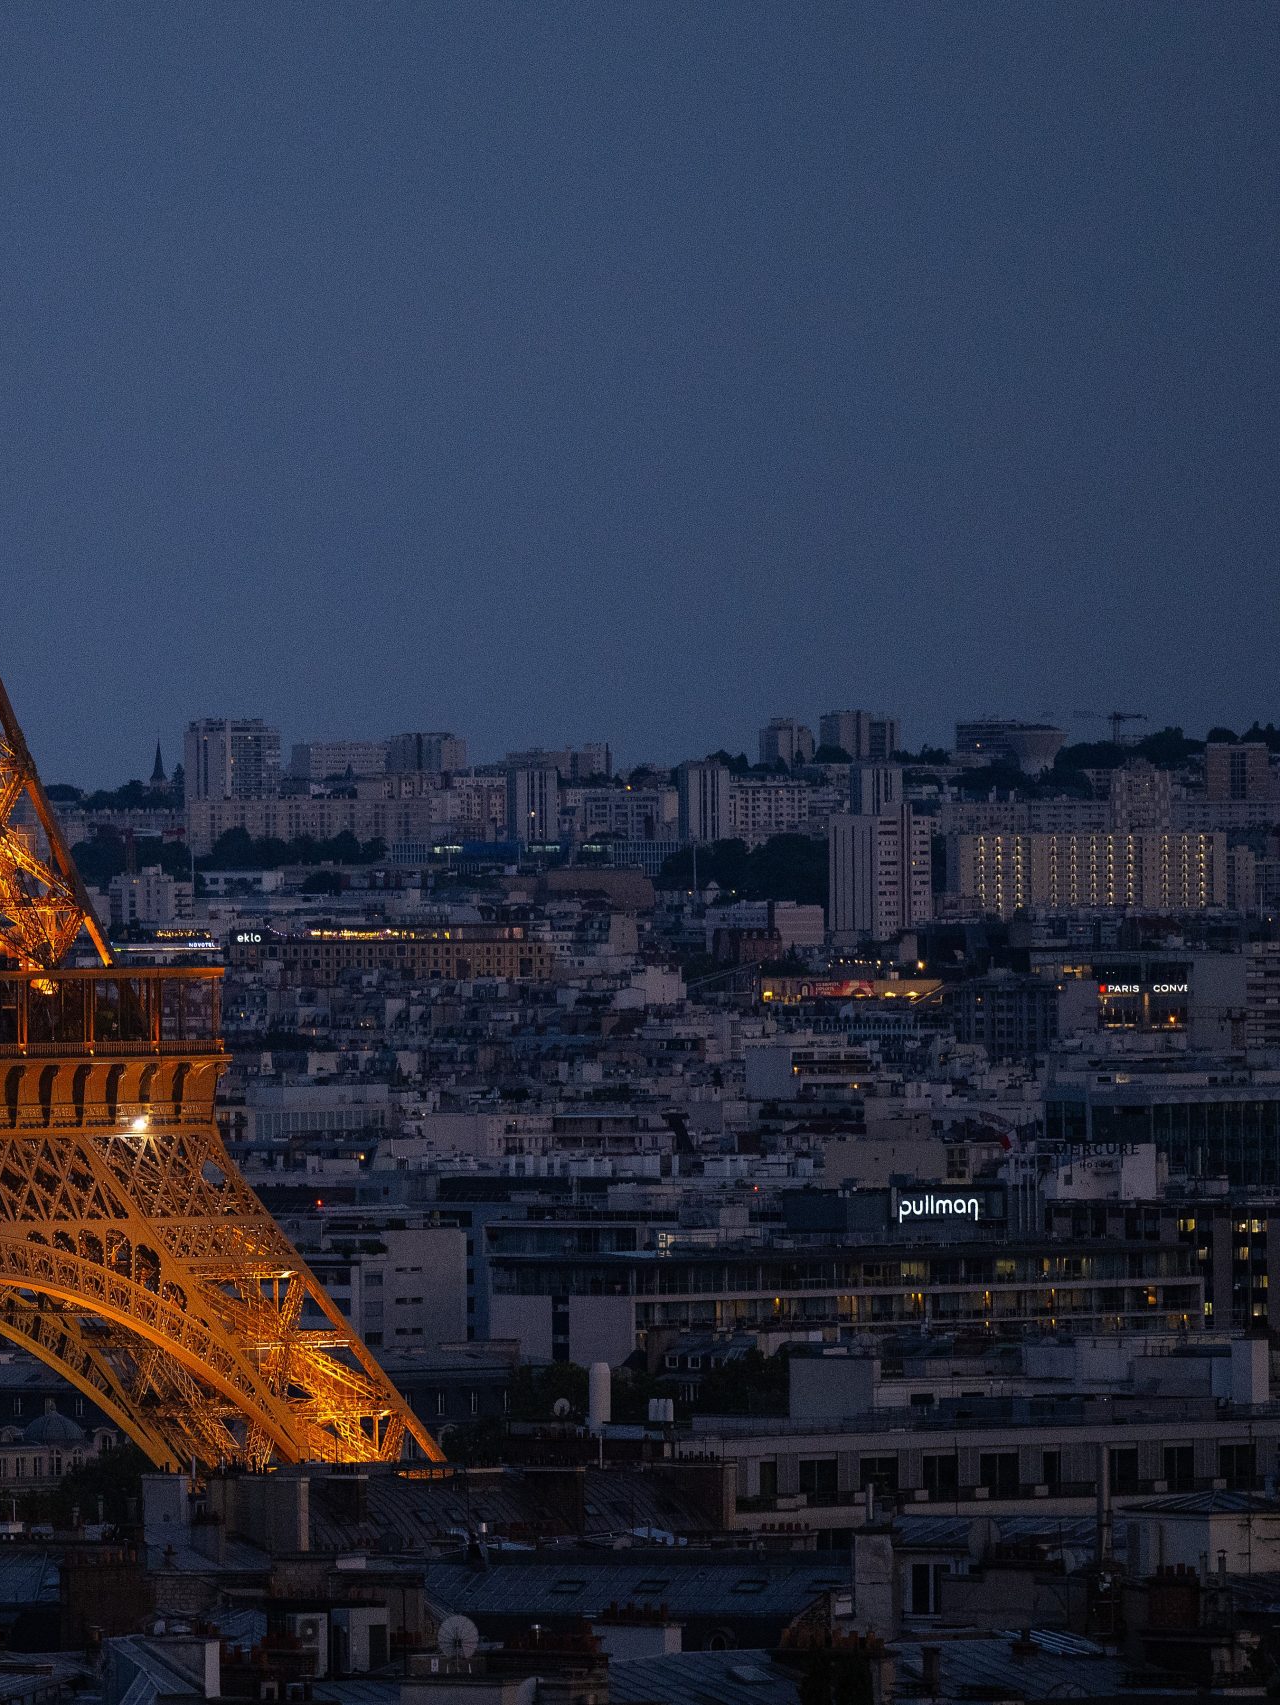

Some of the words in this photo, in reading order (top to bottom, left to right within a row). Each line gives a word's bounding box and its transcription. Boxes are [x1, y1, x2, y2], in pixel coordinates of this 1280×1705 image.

[236, 932, 262, 943] eklo
[1108, 984, 1140, 993] PARIS
[1056, 1143, 1140, 1155] MERCURE
[899, 1195, 979, 1224] pullman
